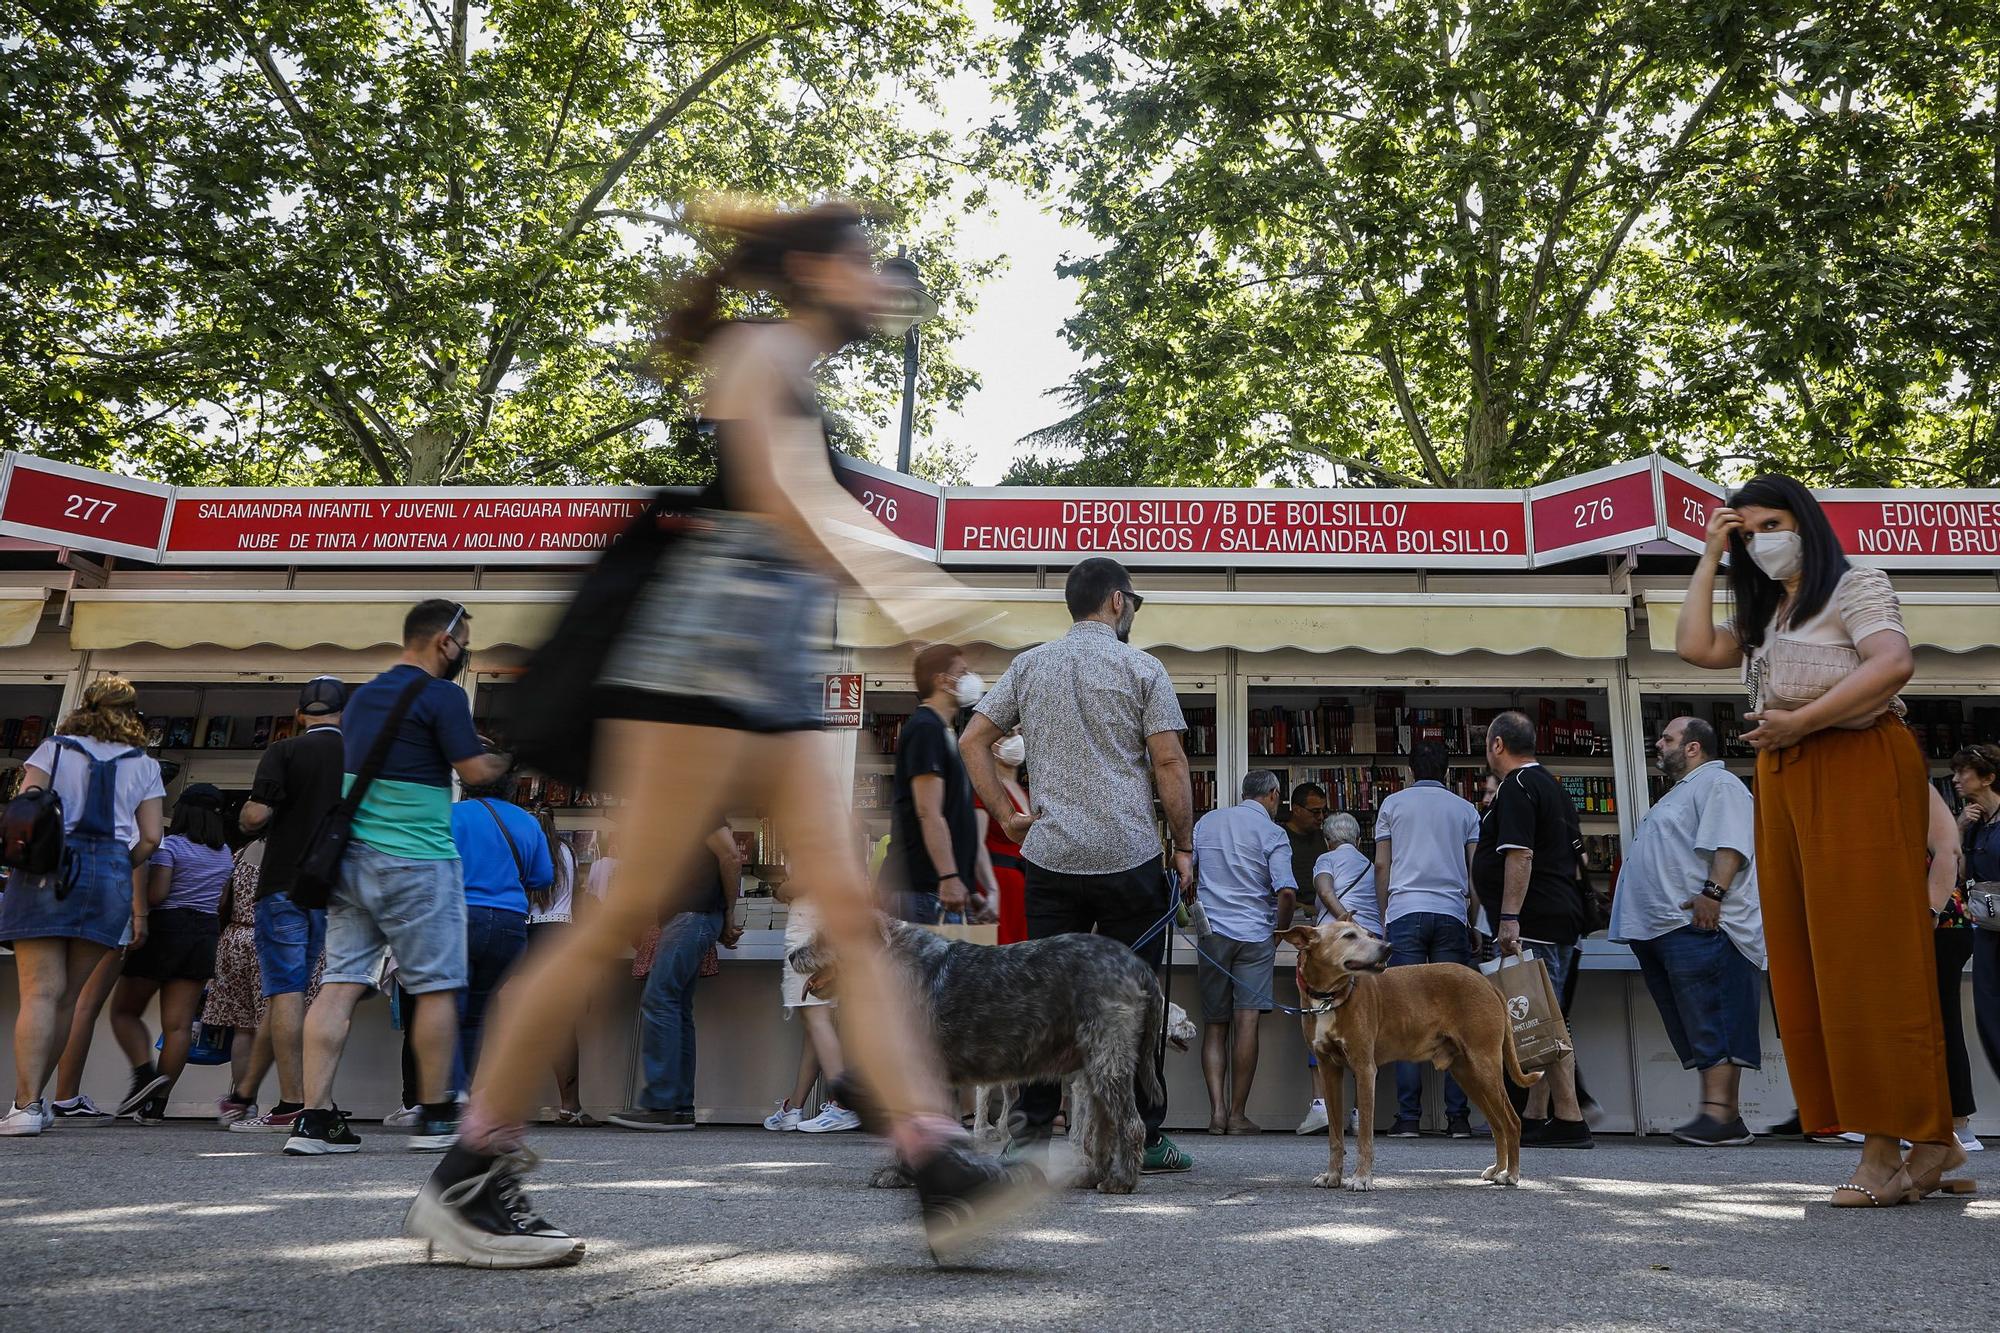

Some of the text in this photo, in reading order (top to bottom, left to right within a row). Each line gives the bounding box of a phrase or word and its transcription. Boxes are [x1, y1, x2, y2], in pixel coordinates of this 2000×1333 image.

[64, 494, 117, 524] 277
[199, 503, 302, 519] SALAMANDRA
[308, 503, 373, 518] INFANTIL
[381, 503, 390, 518] Y
[395, 503, 457, 519] JUVENIL
[462, 503, 471, 518] /
[474, 502, 561, 518] ALFAGUARA
[568, 502, 634, 518] INFANTIL
[863, 490, 898, 522] 276
[1063, 502, 1204, 525] DEBOLSILLO
[1247, 503, 1276, 525] DE
[1574, 497, 1614, 528] 276
[1682, 497, 1705, 527] 275
[1881, 503, 2000, 527] EDICIONES
[238, 533, 279, 549] NUBE
[289, 533, 310, 548] DE
[315, 533, 356, 548] TINTA
[362, 533, 369, 548] /
[373, 533, 447, 548] MONTENA
[453, 533, 460, 548] /
[464, 533, 523, 548] MOLINO
[528, 533, 535, 548] /
[540, 533, 607, 548] RANDOM
[963, 523, 1509, 553] PENGUIN CLÁSICOS / SALAMANDRA BOLSILLO
[1858, 528, 2000, 552] NOVA / BRU
